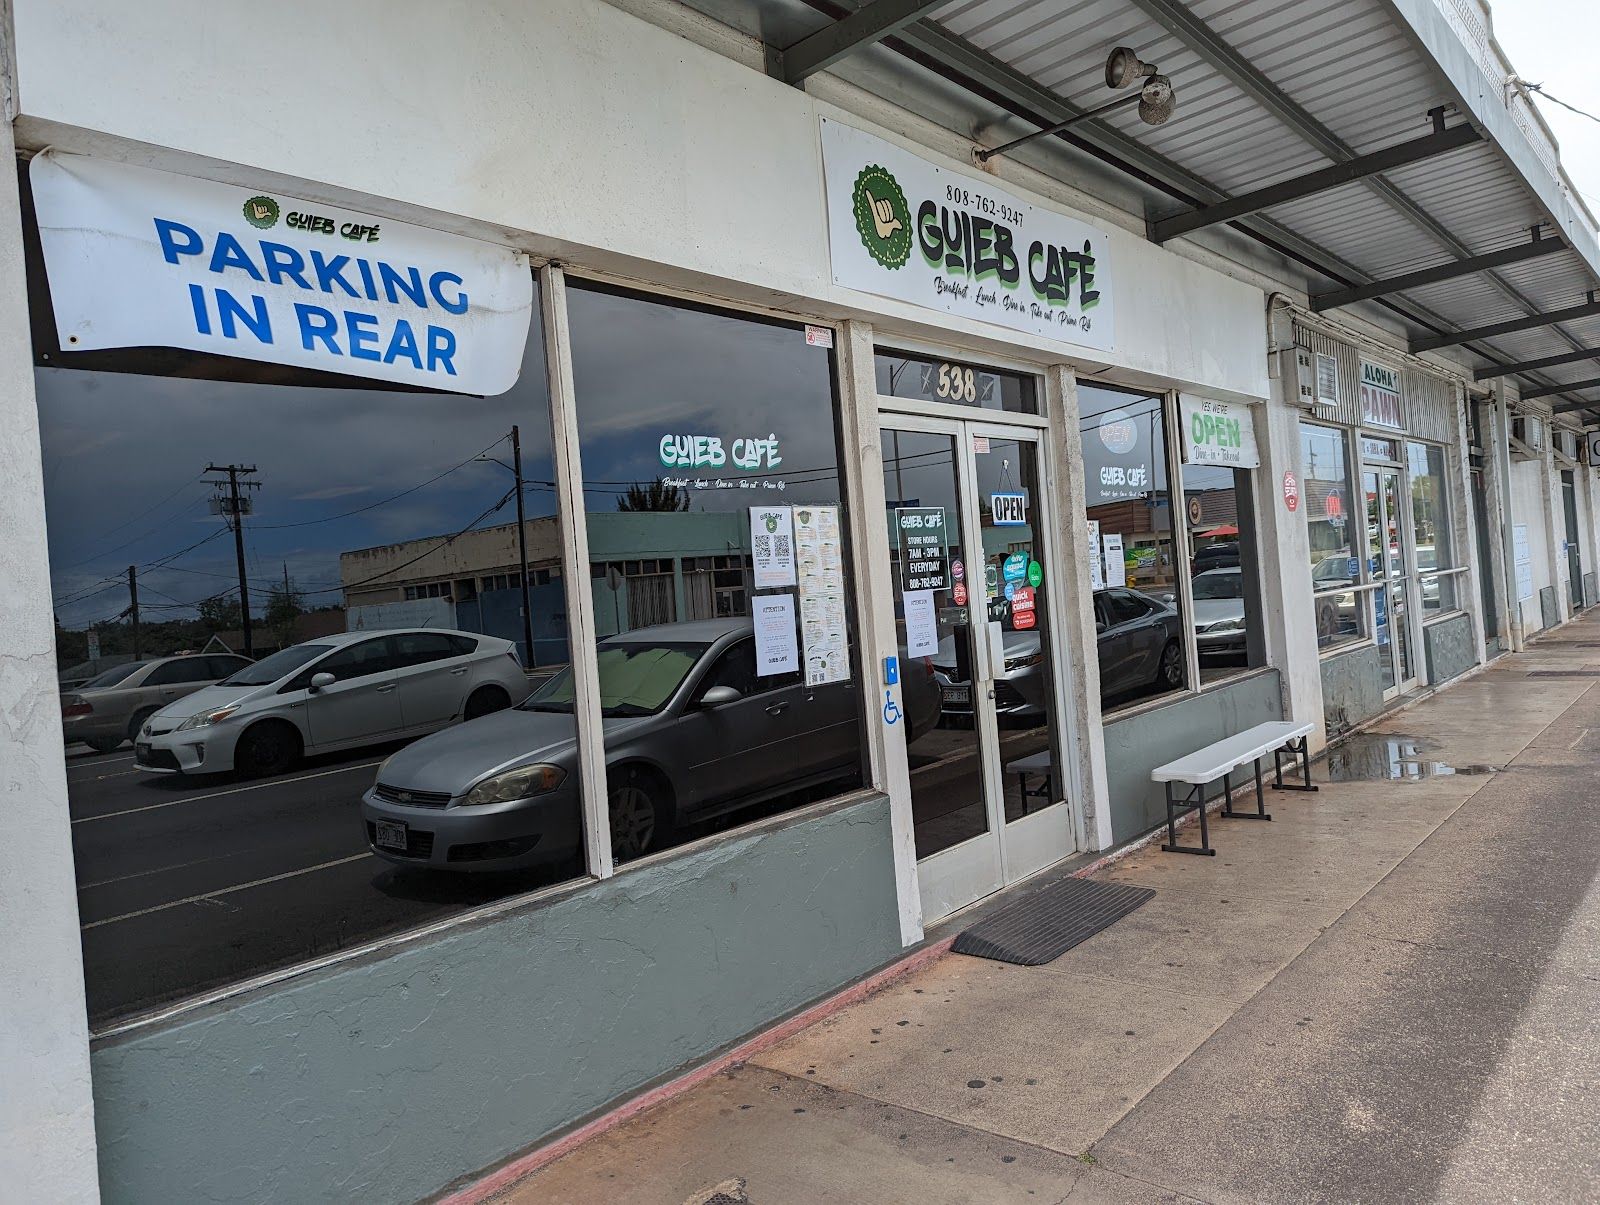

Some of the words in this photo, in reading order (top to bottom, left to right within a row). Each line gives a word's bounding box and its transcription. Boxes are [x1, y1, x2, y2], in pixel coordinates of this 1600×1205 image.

[946, 185, 1024, 228] 808-762-9247
[286, 211, 336, 234] GUIEB
[340, 223, 381, 243] CAFÉ
[153, 217, 469, 315] PARKING
[918, 200, 1020, 290] GUIEB
[1028, 239, 1101, 311] CAFÉ
[934, 276, 969, 300] Breakfast
[976, 286, 997, 306] Lunch
[1002, 294, 1018, 311] Dine
[1030, 303, 1043, 319] Take
[1058, 310, 1078, 327] Prime
[188, 283, 274, 345] IN
[294, 303, 458, 376] REAR
[936, 363, 977, 403] 538
[1364, 363, 1393, 388] ALOHA
[1361, 386, 1402, 427] PAWN
[1191, 412, 1241, 448] OPEN
[659, 434, 727, 469] GUIEB
[732, 432, 783, 470] CAFÉ
[1100, 466, 1126, 486] GUIEB
[900, 515, 923, 529] GUIEB
[994, 496, 1025, 521] OPEN
[907, 536, 922, 545] STORE
[923, 535, 938, 544] HOURS
[908, 548, 922, 559] 7AM
[926, 547, 940, 558] 3PM
[909, 561, 941, 574] EVERYDAY
[909, 576, 944, 589] 808-762-9247
[1012, 590, 1029, 604] quick
[1013, 600, 1033, 611] cuisine
